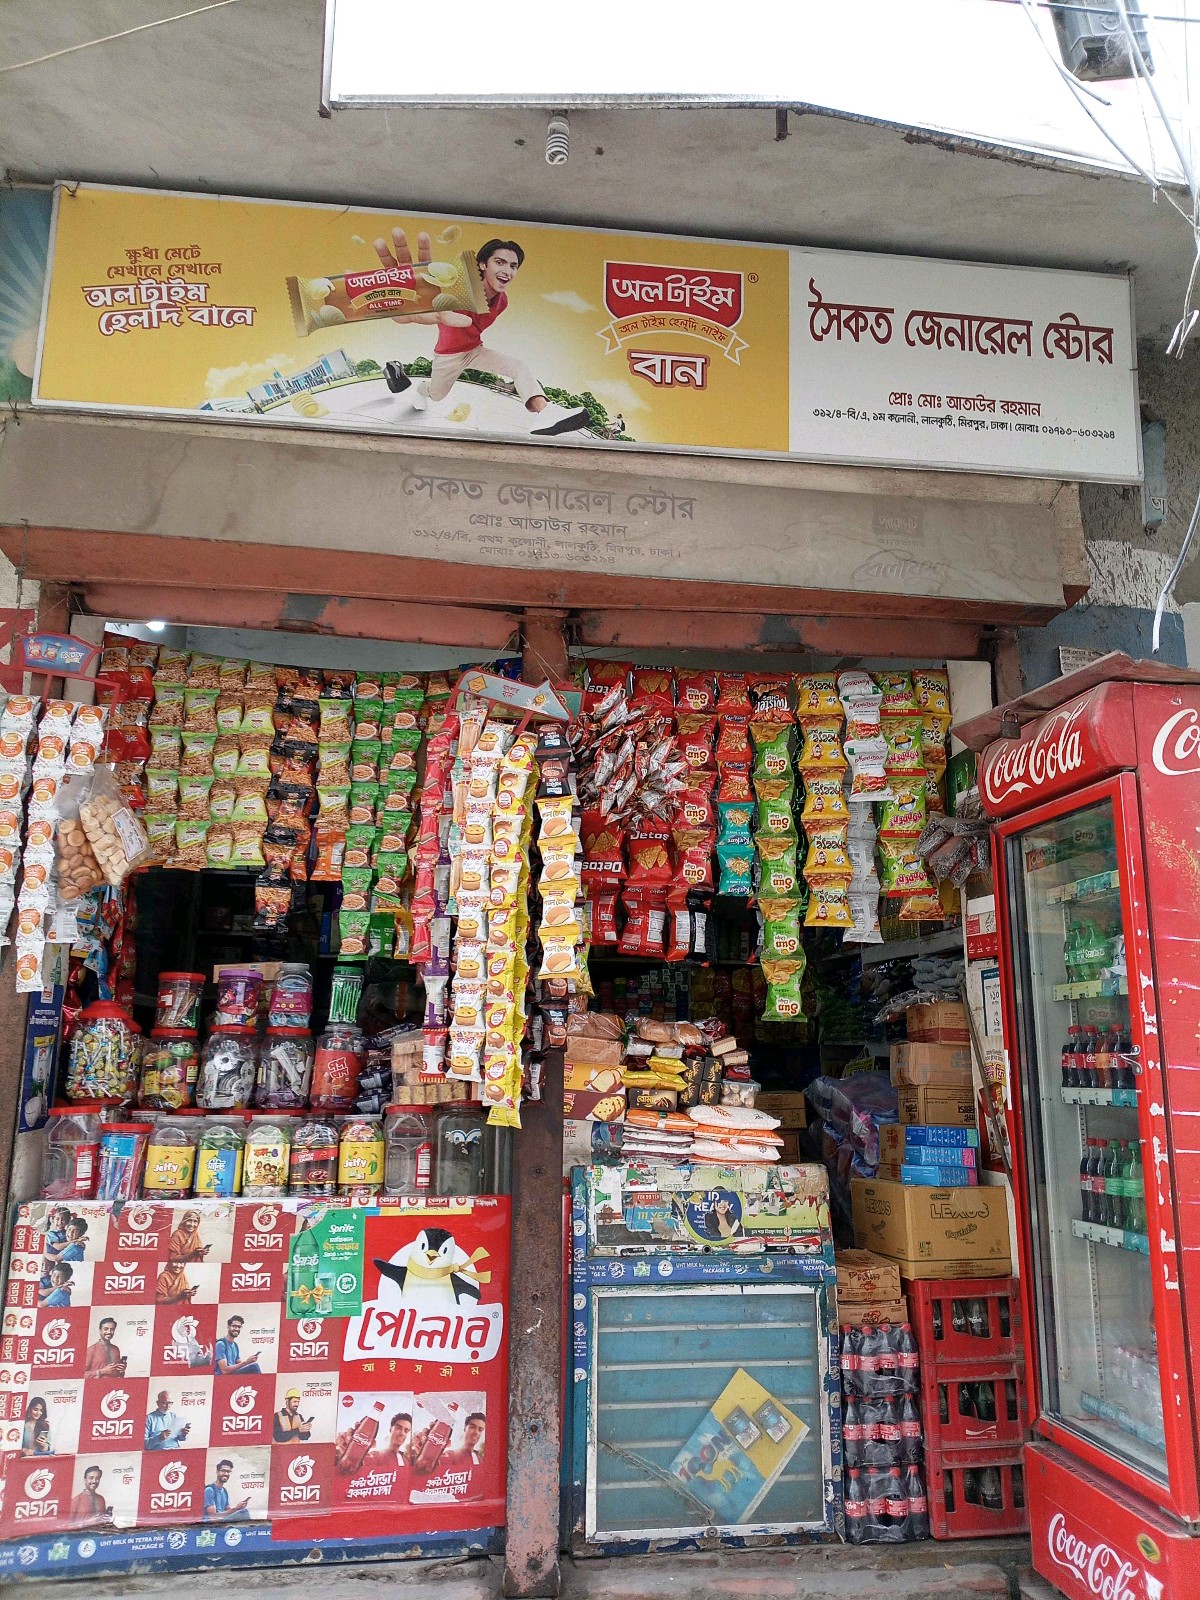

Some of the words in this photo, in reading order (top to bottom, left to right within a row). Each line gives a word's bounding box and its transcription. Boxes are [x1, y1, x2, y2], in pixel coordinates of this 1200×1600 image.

[125, 246, 159, 264] ক্ষুধা
[165, 244, 201, 261] মেটে
[107, 263, 162, 279] যেখানে
[168, 262, 223, 277] সেখানে
[99, 303, 184, 336] হেলদি
[189, 305, 256, 328] বানে
[808, 278, 894, 345] সৈকত
[904, 309, 1033, 357] জেনারেল
[1043, 312, 1114, 365] ষ্টোর
[619, 322, 638, 334] অল
[642, 315, 666, 329] টাইম
[701, 322, 729, 343] লাইফ
[629, 351, 707, 388] বান
[946, 394, 996, 413] আতাউর
[999, 400, 1042, 417] রহমান
[872, 413, 886, 422] ১ম
[1041, 425, 1116, 440] ০১৭১৩-৬০৩২৯৪
[497, 481, 617, 515] জেনারেল
[507, 515, 573, 533] আতাউর
[577, 521, 628, 538] রহমান
[687, 692, 709, 706] Sun
[685, 749, 708, 763] Sun
[985, 698, 1091, 804] Coca-Cola
[767, 758, 787, 771] Sun
[685, 806, 708, 820] Sun
[770, 818, 790, 831] Sun
[630, 830, 670, 842] Detos
[582, 860, 623, 874] Detos
[683, 868, 706, 881] Sun
[772, 877, 793, 890] Sun
[775, 938, 796, 951] Sun
[778, 1002, 799, 1015] Sun
[708, 1191, 720, 1201] ID
[328, 1222, 356, 1235] Sprite
[118, 1232, 159, 1248] নগদ
[244, 1232, 284, 1249] নগদ
[104, 1274, 146, 1292] নগদ
[231, 1272, 271, 1289] নগদ
[357, 1306, 491, 1362] পোলার
[33, 1347, 75, 1365] নগদ
[290, 1341, 329, 1358] নগদ
[92, 1419, 134, 1437] নগদ
[222, 1414, 263, 1432] নগদ
[366, 1471, 393, 1487] ঠান্ডা
[442, 1470, 469, 1486] ঠান্ডা
[150, 1490, 193, 1510] নগদ
[281, 1484, 320, 1502] নগদ
[14, 1498, 59, 1519] নগদ
[131, 1543, 158, 1551] PACKAGE
